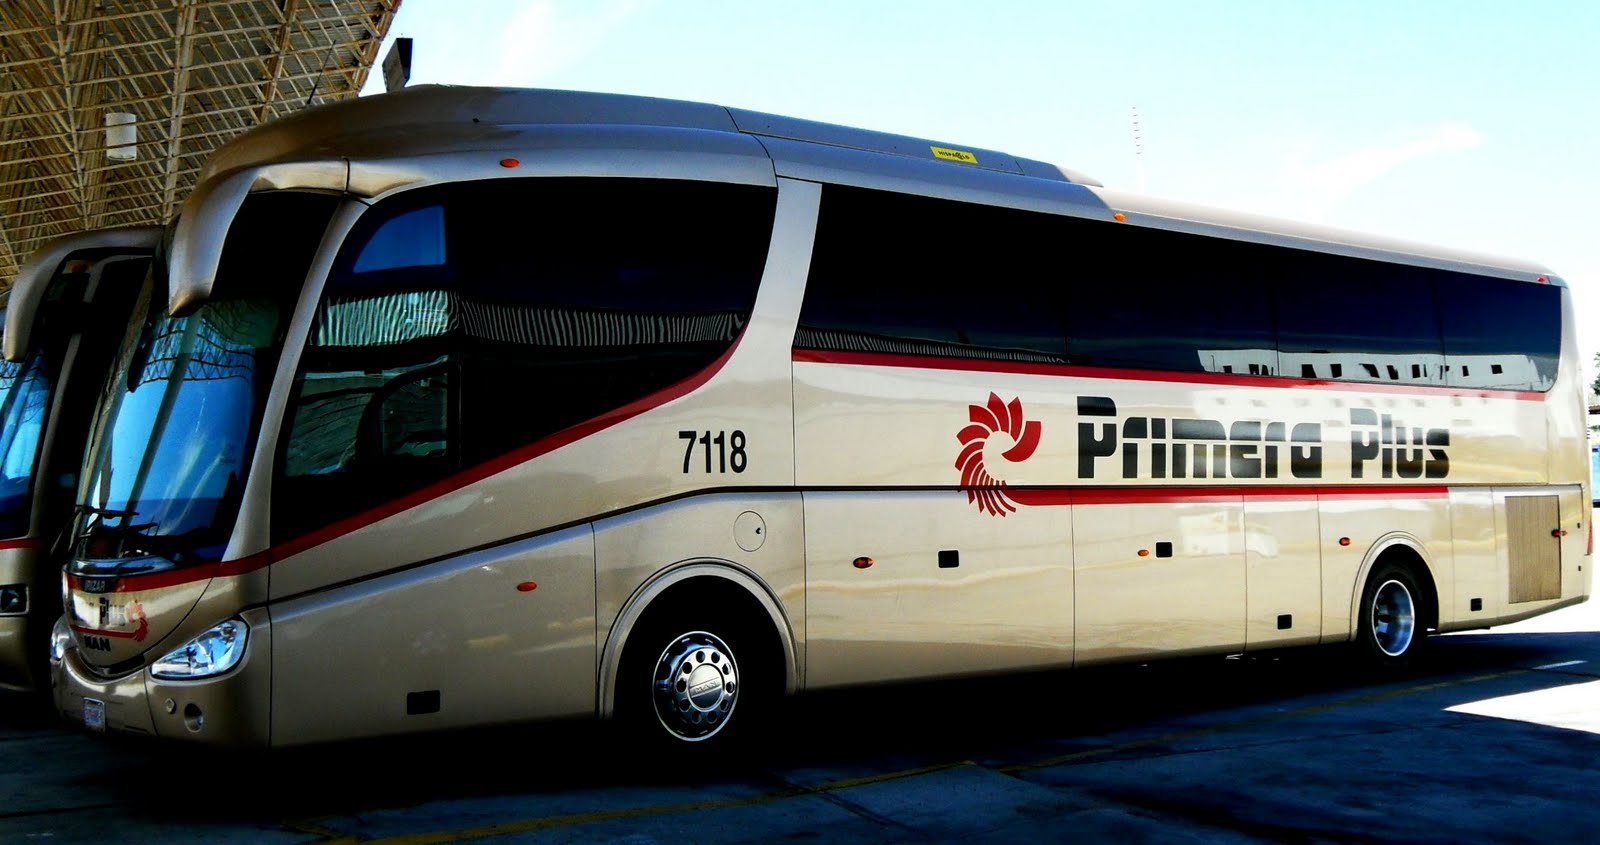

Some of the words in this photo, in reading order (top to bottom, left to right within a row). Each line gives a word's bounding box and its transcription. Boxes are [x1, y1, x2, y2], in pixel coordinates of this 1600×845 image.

[678, 430, 747, 474] 7118
[1077, 395, 1323, 479] Primera
[1350, 407, 1451, 479] Plus
